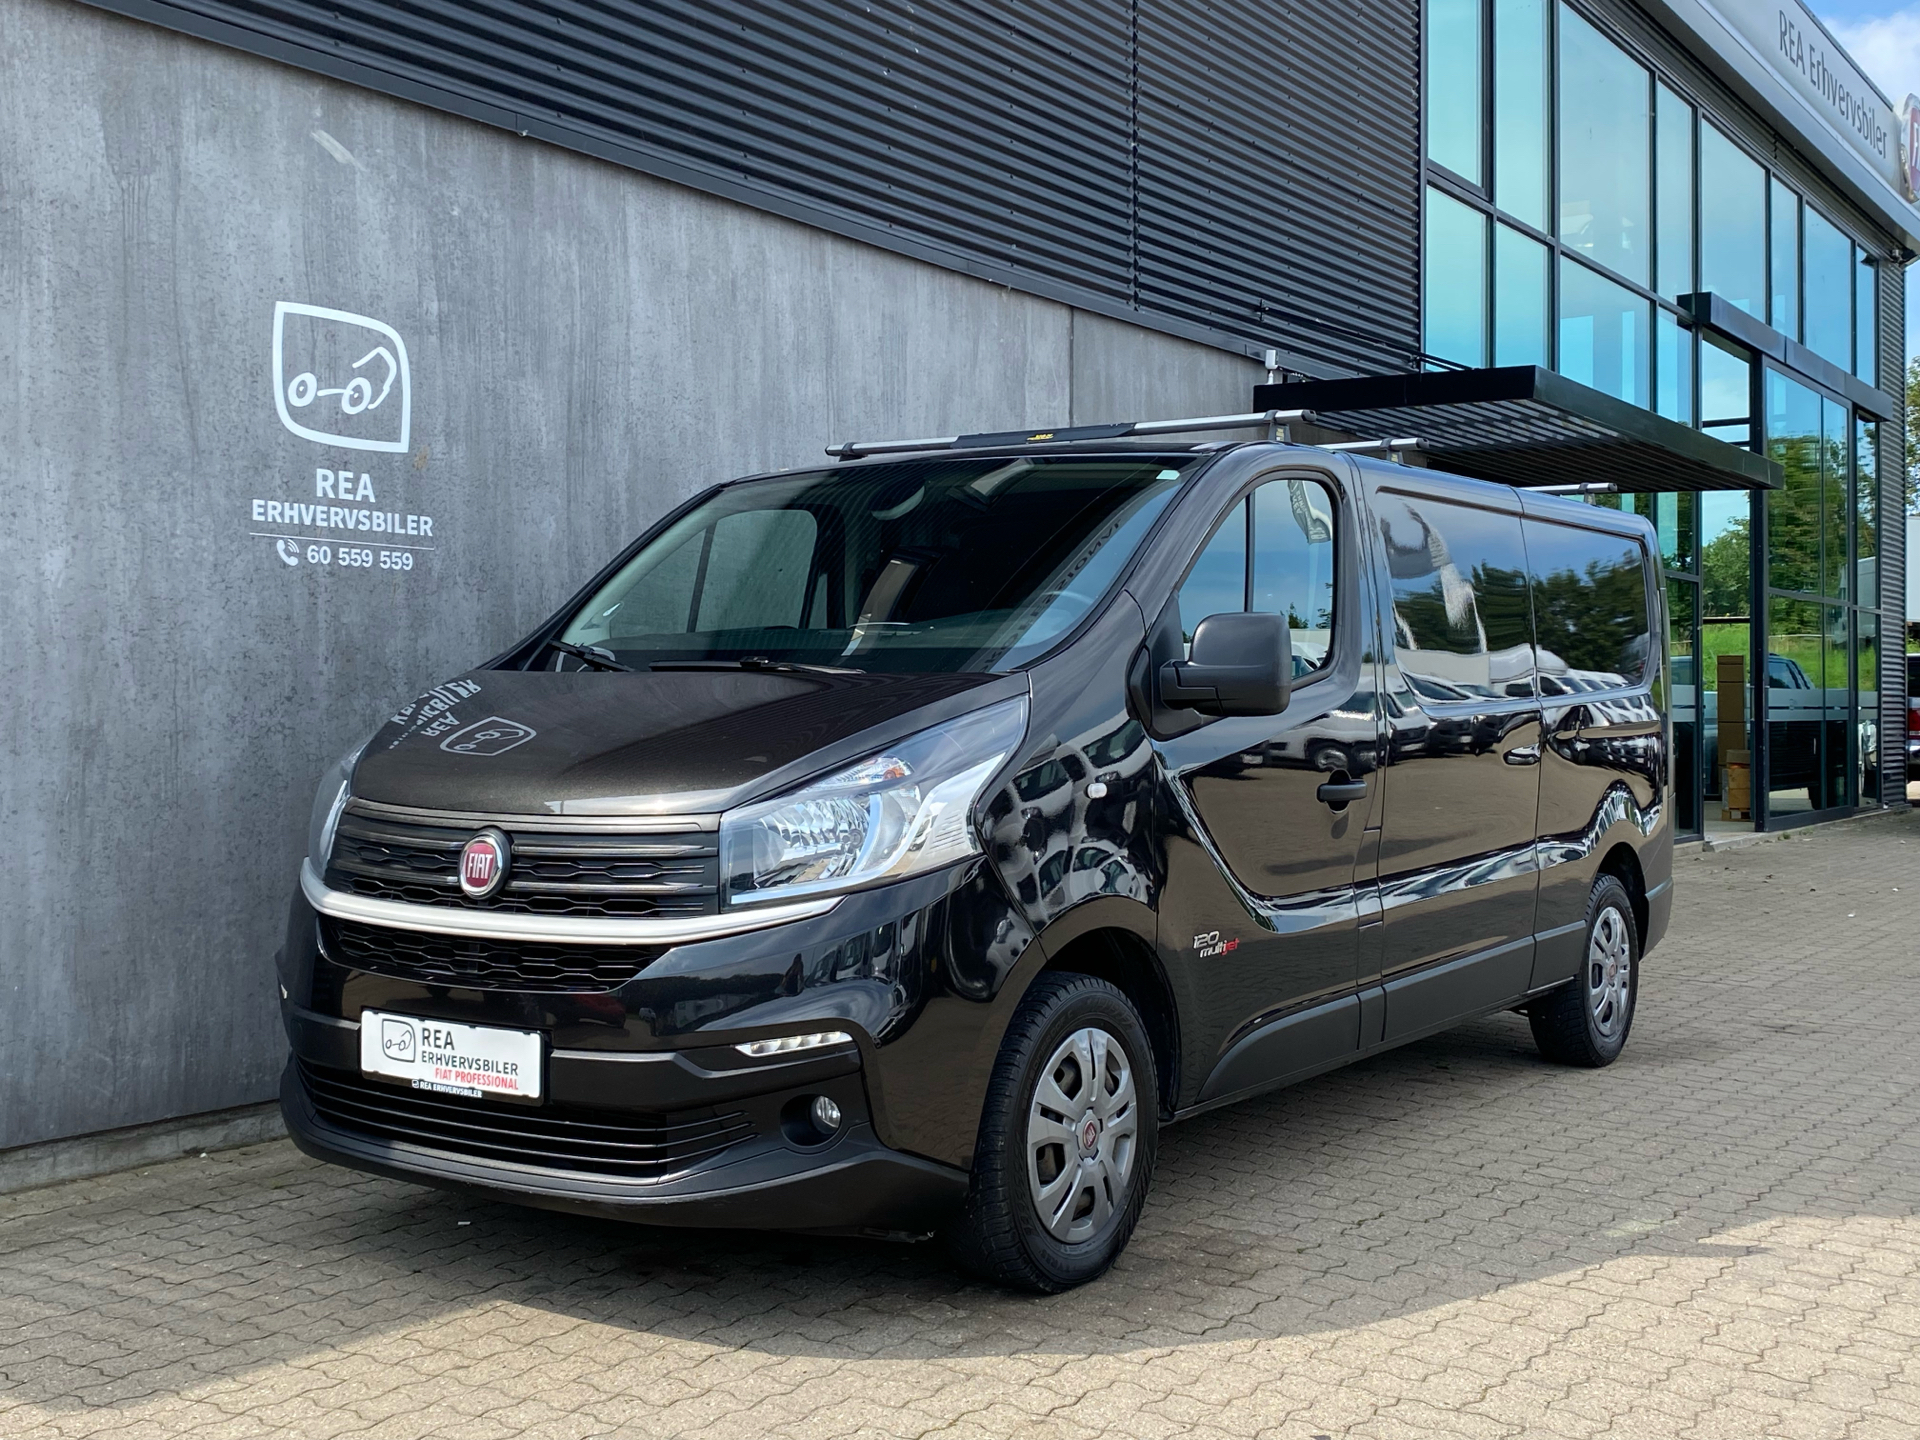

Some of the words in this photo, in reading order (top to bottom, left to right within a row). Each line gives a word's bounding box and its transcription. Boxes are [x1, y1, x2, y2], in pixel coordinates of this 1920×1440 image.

[1779, 9, 1806, 76] REA
[1809, 43, 1888, 160] Erhvervsbiler
[316, 468, 376, 503] REA
[251, 499, 433, 537] ERHVERVSBILER
[306, 545, 331, 565] 60
[338, 548, 373, 569] 559
[379, 551, 413, 571] 559
[466, 852, 494, 880] FIAT
[1193, 930, 1220, 949] 120
[1199, 937, 1240, 958] multijet
[421, 1028, 455, 1051] REA
[421, 1050, 519, 1076] ERHVERVSBILER
[420, 1081, 433, 1090] REA
[434, 1067, 453, 1081] FIAT
[454, 1070, 519, 1091] PROFESSIONAL
